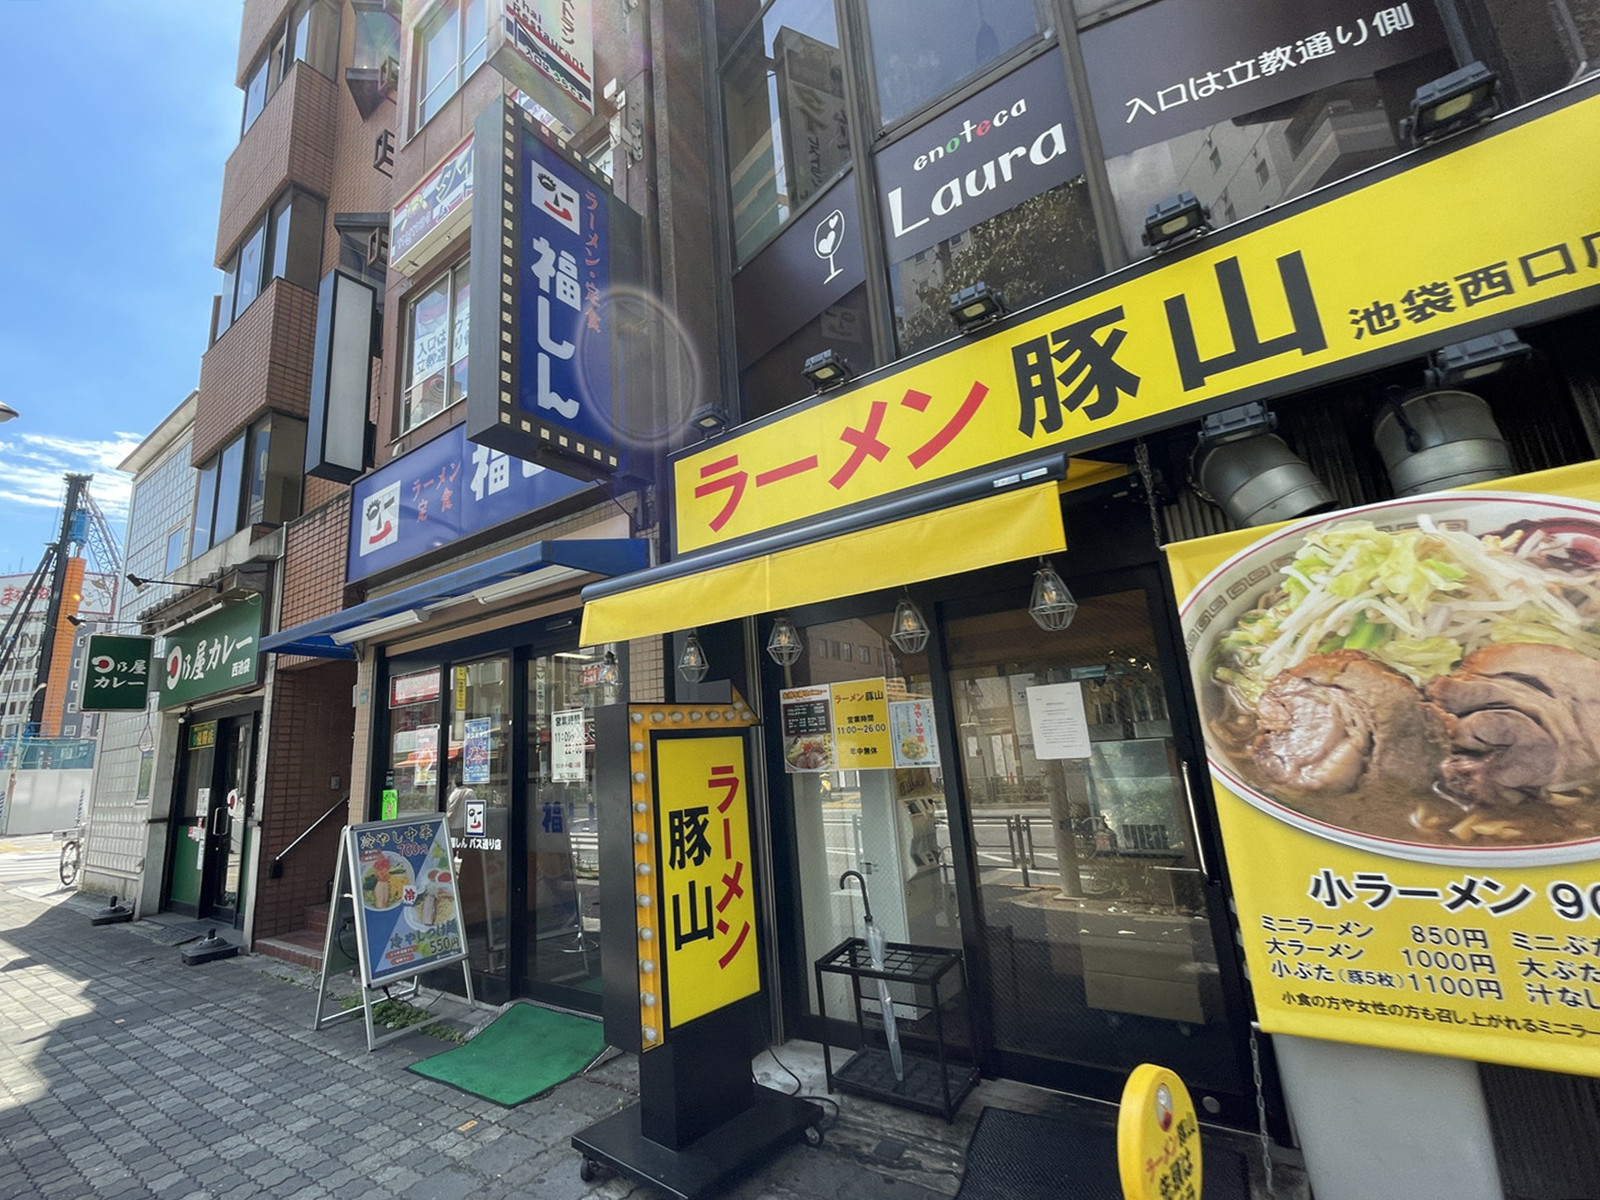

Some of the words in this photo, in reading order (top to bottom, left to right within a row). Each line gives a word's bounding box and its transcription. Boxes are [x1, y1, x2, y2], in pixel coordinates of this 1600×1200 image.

[513, 2, 585, 71] Restaurant
[560, 0, 575, 45] トラン
[1125, 3, 1415, 124] 入口は立教通り側
[913, 98, 1028, 171] enoteca
[888, 123, 1068, 238] Laura
[531, 236, 581, 420] 福しん
[694, 250, 1328, 533] ラーメン豚山
[412, 460, 461, 501] ラーメン
[93, 676, 145, 689] カレー
[668, 806, 715, 952] 豚山
[708, 765, 751, 970] ラーメン
[1308, 867, 1535, 915] 小ラーメン
[1261, 915, 1374, 939] ミニラーメン
[1411, 925, 1490, 949] 850円
[1266, 937, 1365, 961] 大ラーメン
[1402, 950, 1497, 975] 1000円
[1411, 974, 1503, 999] 1100円
